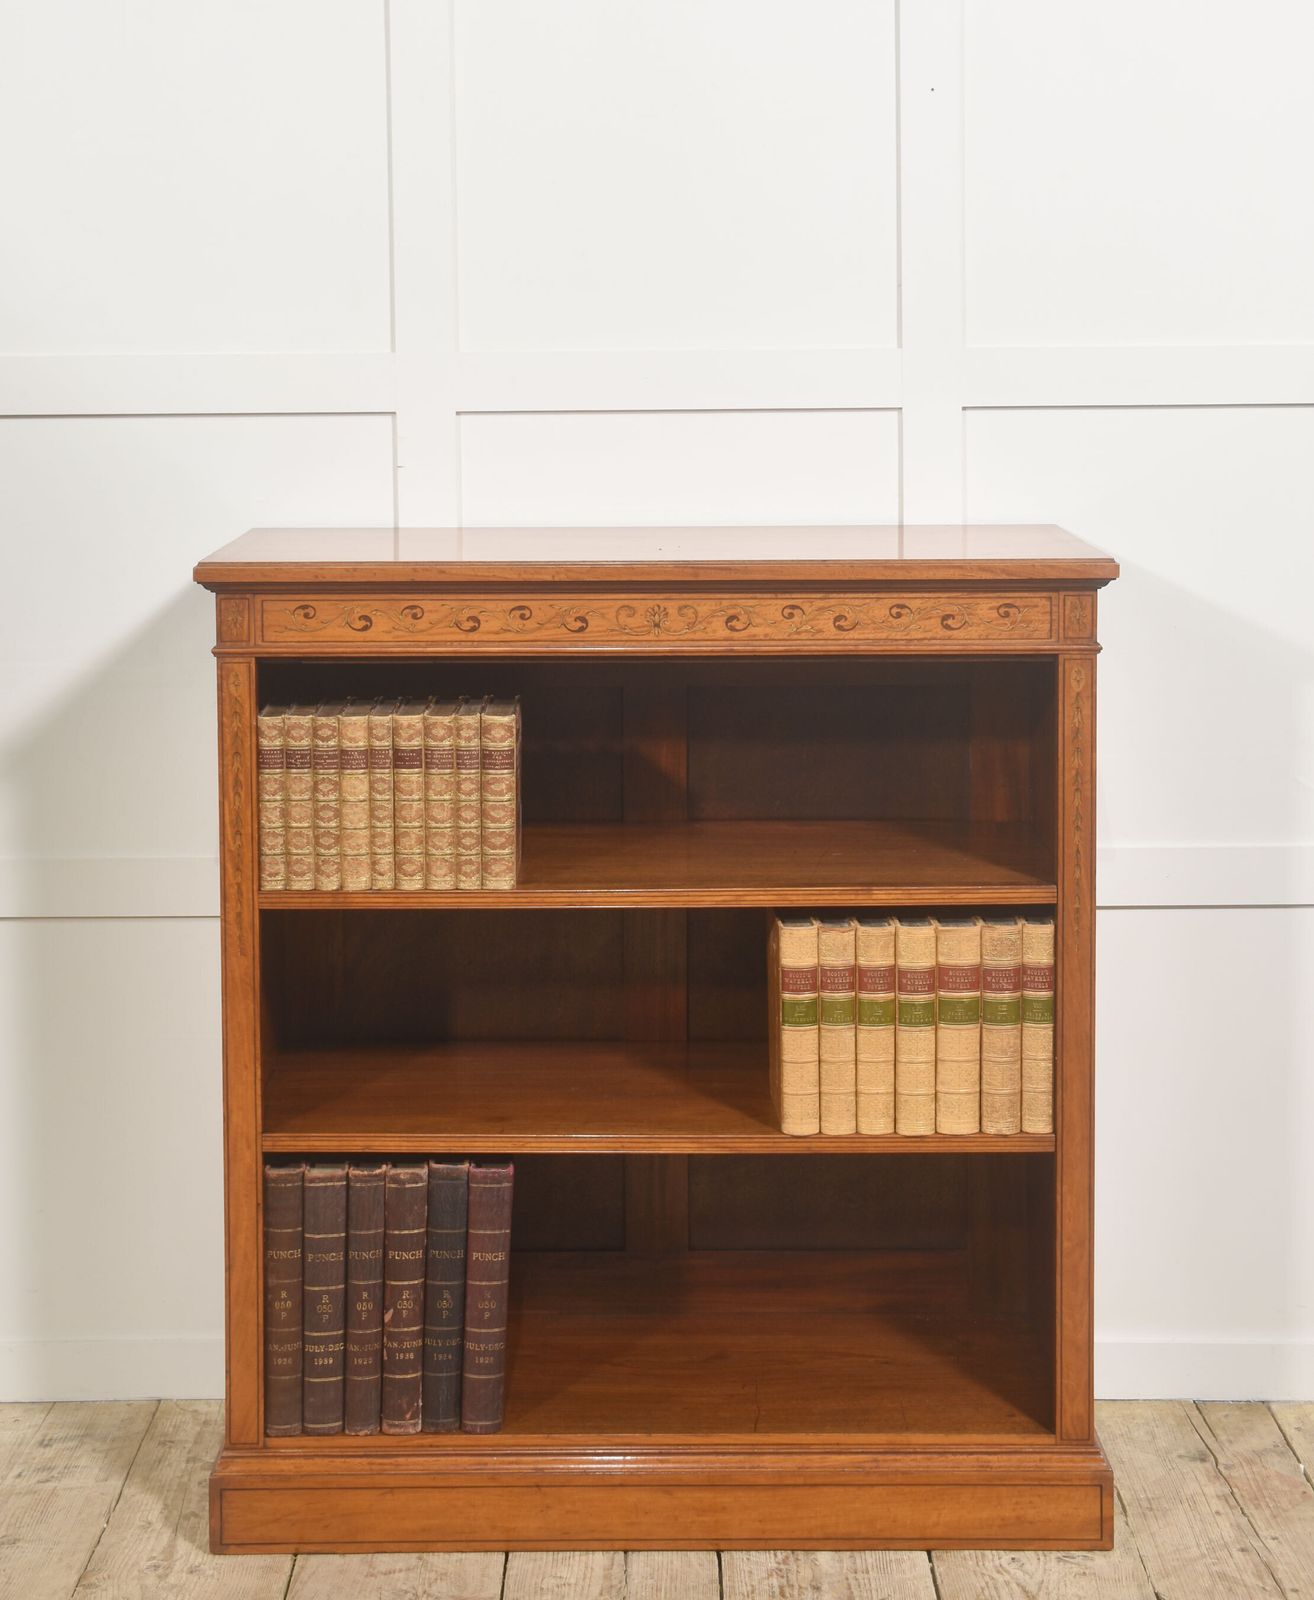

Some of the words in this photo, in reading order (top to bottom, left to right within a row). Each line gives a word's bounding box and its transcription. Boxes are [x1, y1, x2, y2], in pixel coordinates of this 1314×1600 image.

[267, 1249, 301, 1259] PUNCH
[307, 1252, 344, 1262] PUNCH
[348, 1249, 382, 1260] PUNCH
[388, 1249, 424, 1260] PUNCH
[430, 1249, 464, 1260] PUNCH
[472, 1252, 505, 1262] PUNCH
[280, 1290, 288, 1298] R
[362, 1291, 369, 1300] R
[402, 1290, 410, 1299] R
[443, 1290, 450, 1298] R
[322, 1294, 329, 1304] R
[280, 1312, 288, 1320] P
[322, 1314, 328, 1323] P
[402, 1310, 409, 1318] P
[442, 1310, 450, 1319] P
[484, 1311, 490, 1320] P
